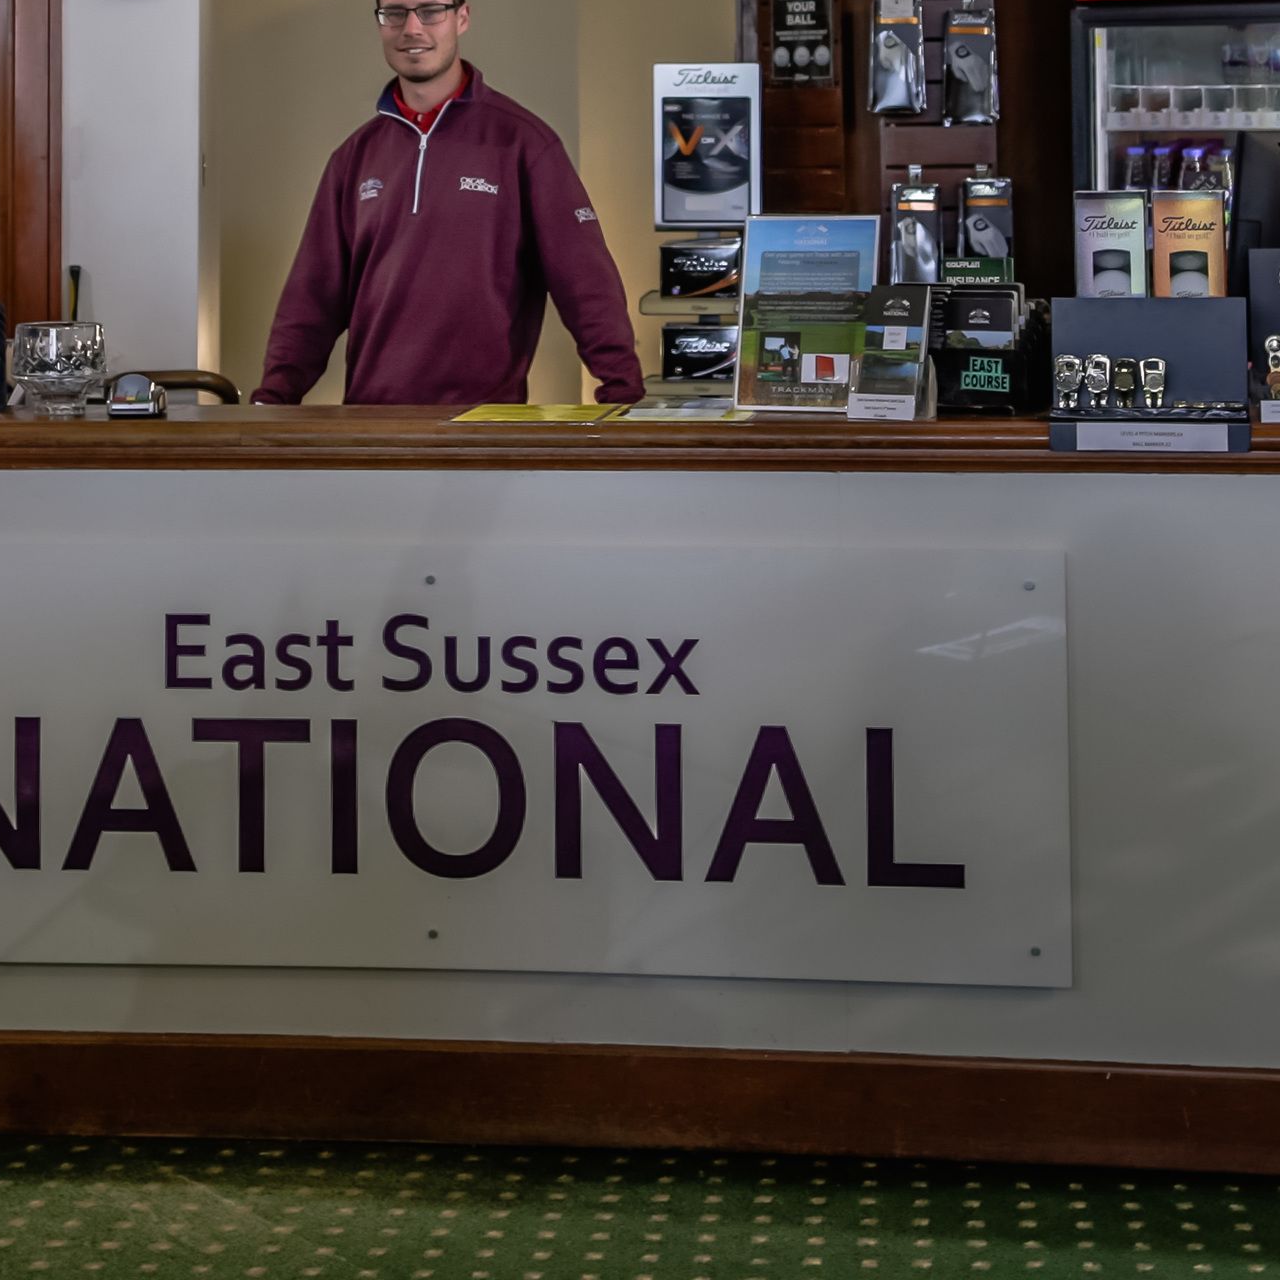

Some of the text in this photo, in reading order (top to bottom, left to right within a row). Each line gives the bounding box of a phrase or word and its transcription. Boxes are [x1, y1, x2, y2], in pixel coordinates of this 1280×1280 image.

[786, 1, 816, 12] YOUR
[786, 14, 816, 26] BALL.
[673, 67, 739, 87] Titleist
[1080, 215, 1139, 232] Titleist
[1158, 216, 1217, 233] Titleist
[971, 358, 1001, 373] EAST
[771, 385, 834, 394] TRACKMAN
[963, 374, 1008, 390] COURSE
[162, 610, 702, 699] East Sussex
